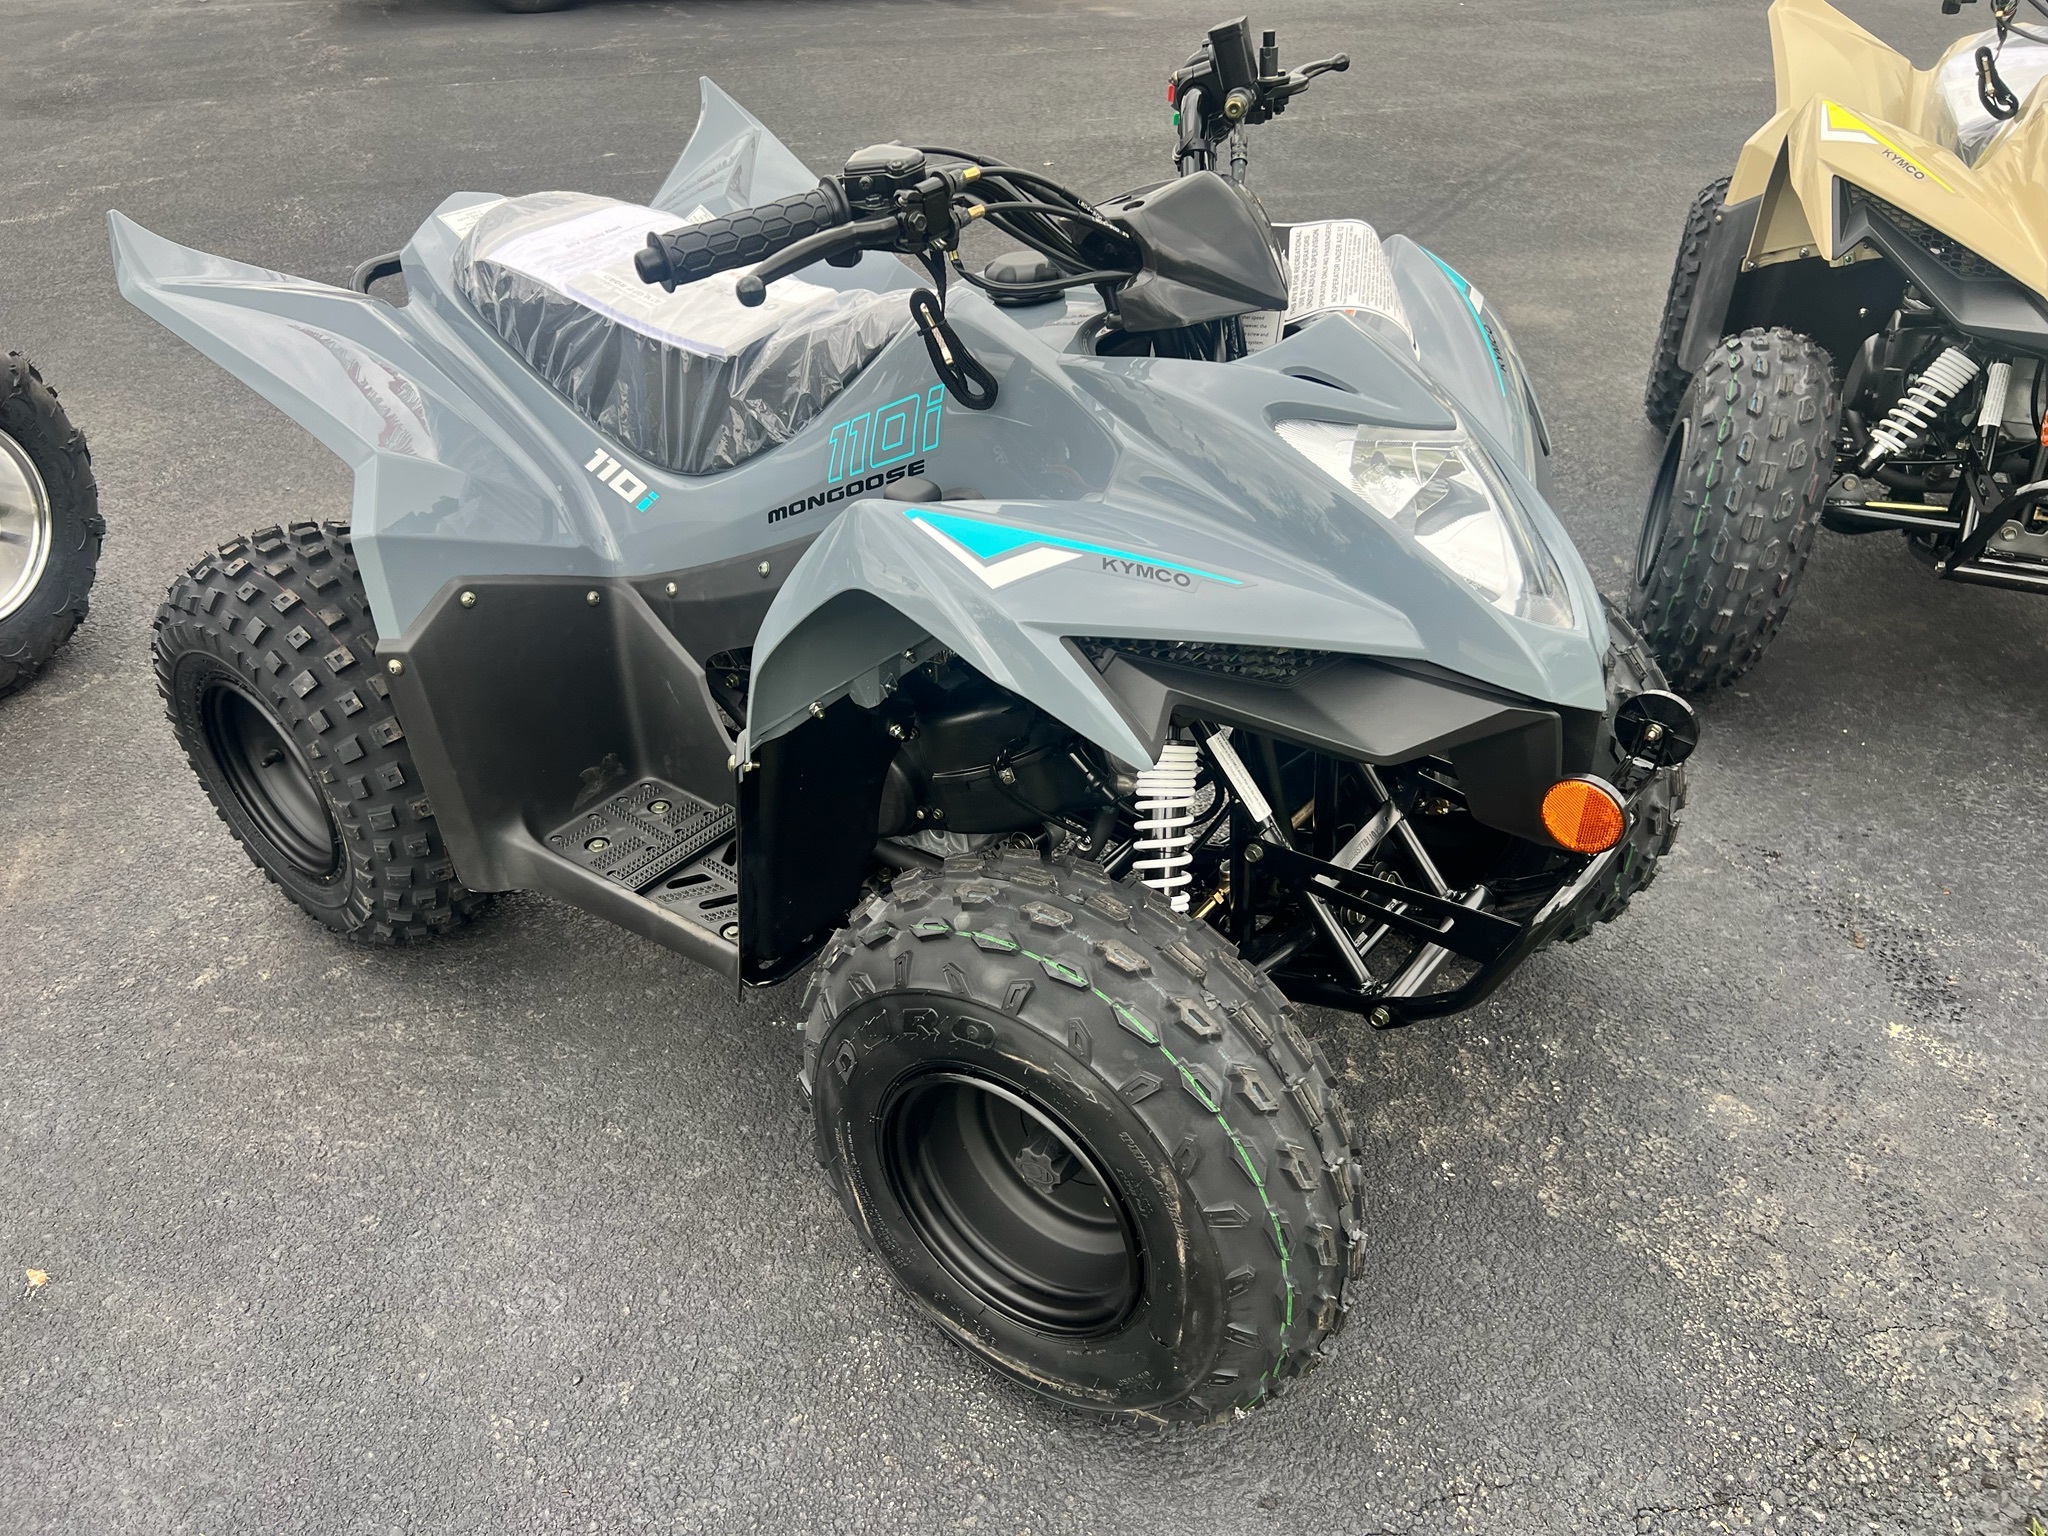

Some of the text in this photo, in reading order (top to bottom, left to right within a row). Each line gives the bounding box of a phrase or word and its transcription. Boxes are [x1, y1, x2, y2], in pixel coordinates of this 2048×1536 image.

[1882, 149, 1925, 179] KYMCO
[1336, 233, 1344, 243] AGE
[1334, 244, 1343, 263] UNDER
[1331, 264, 1341, 293] OPERATOR
[1331, 293, 1338, 303] NO
[828, 384, 945, 484] 110i
[584, 447, 660, 513] 110i
[768, 459, 925, 524] MONGOOSE
[1102, 557, 1191, 588] KYMCO
